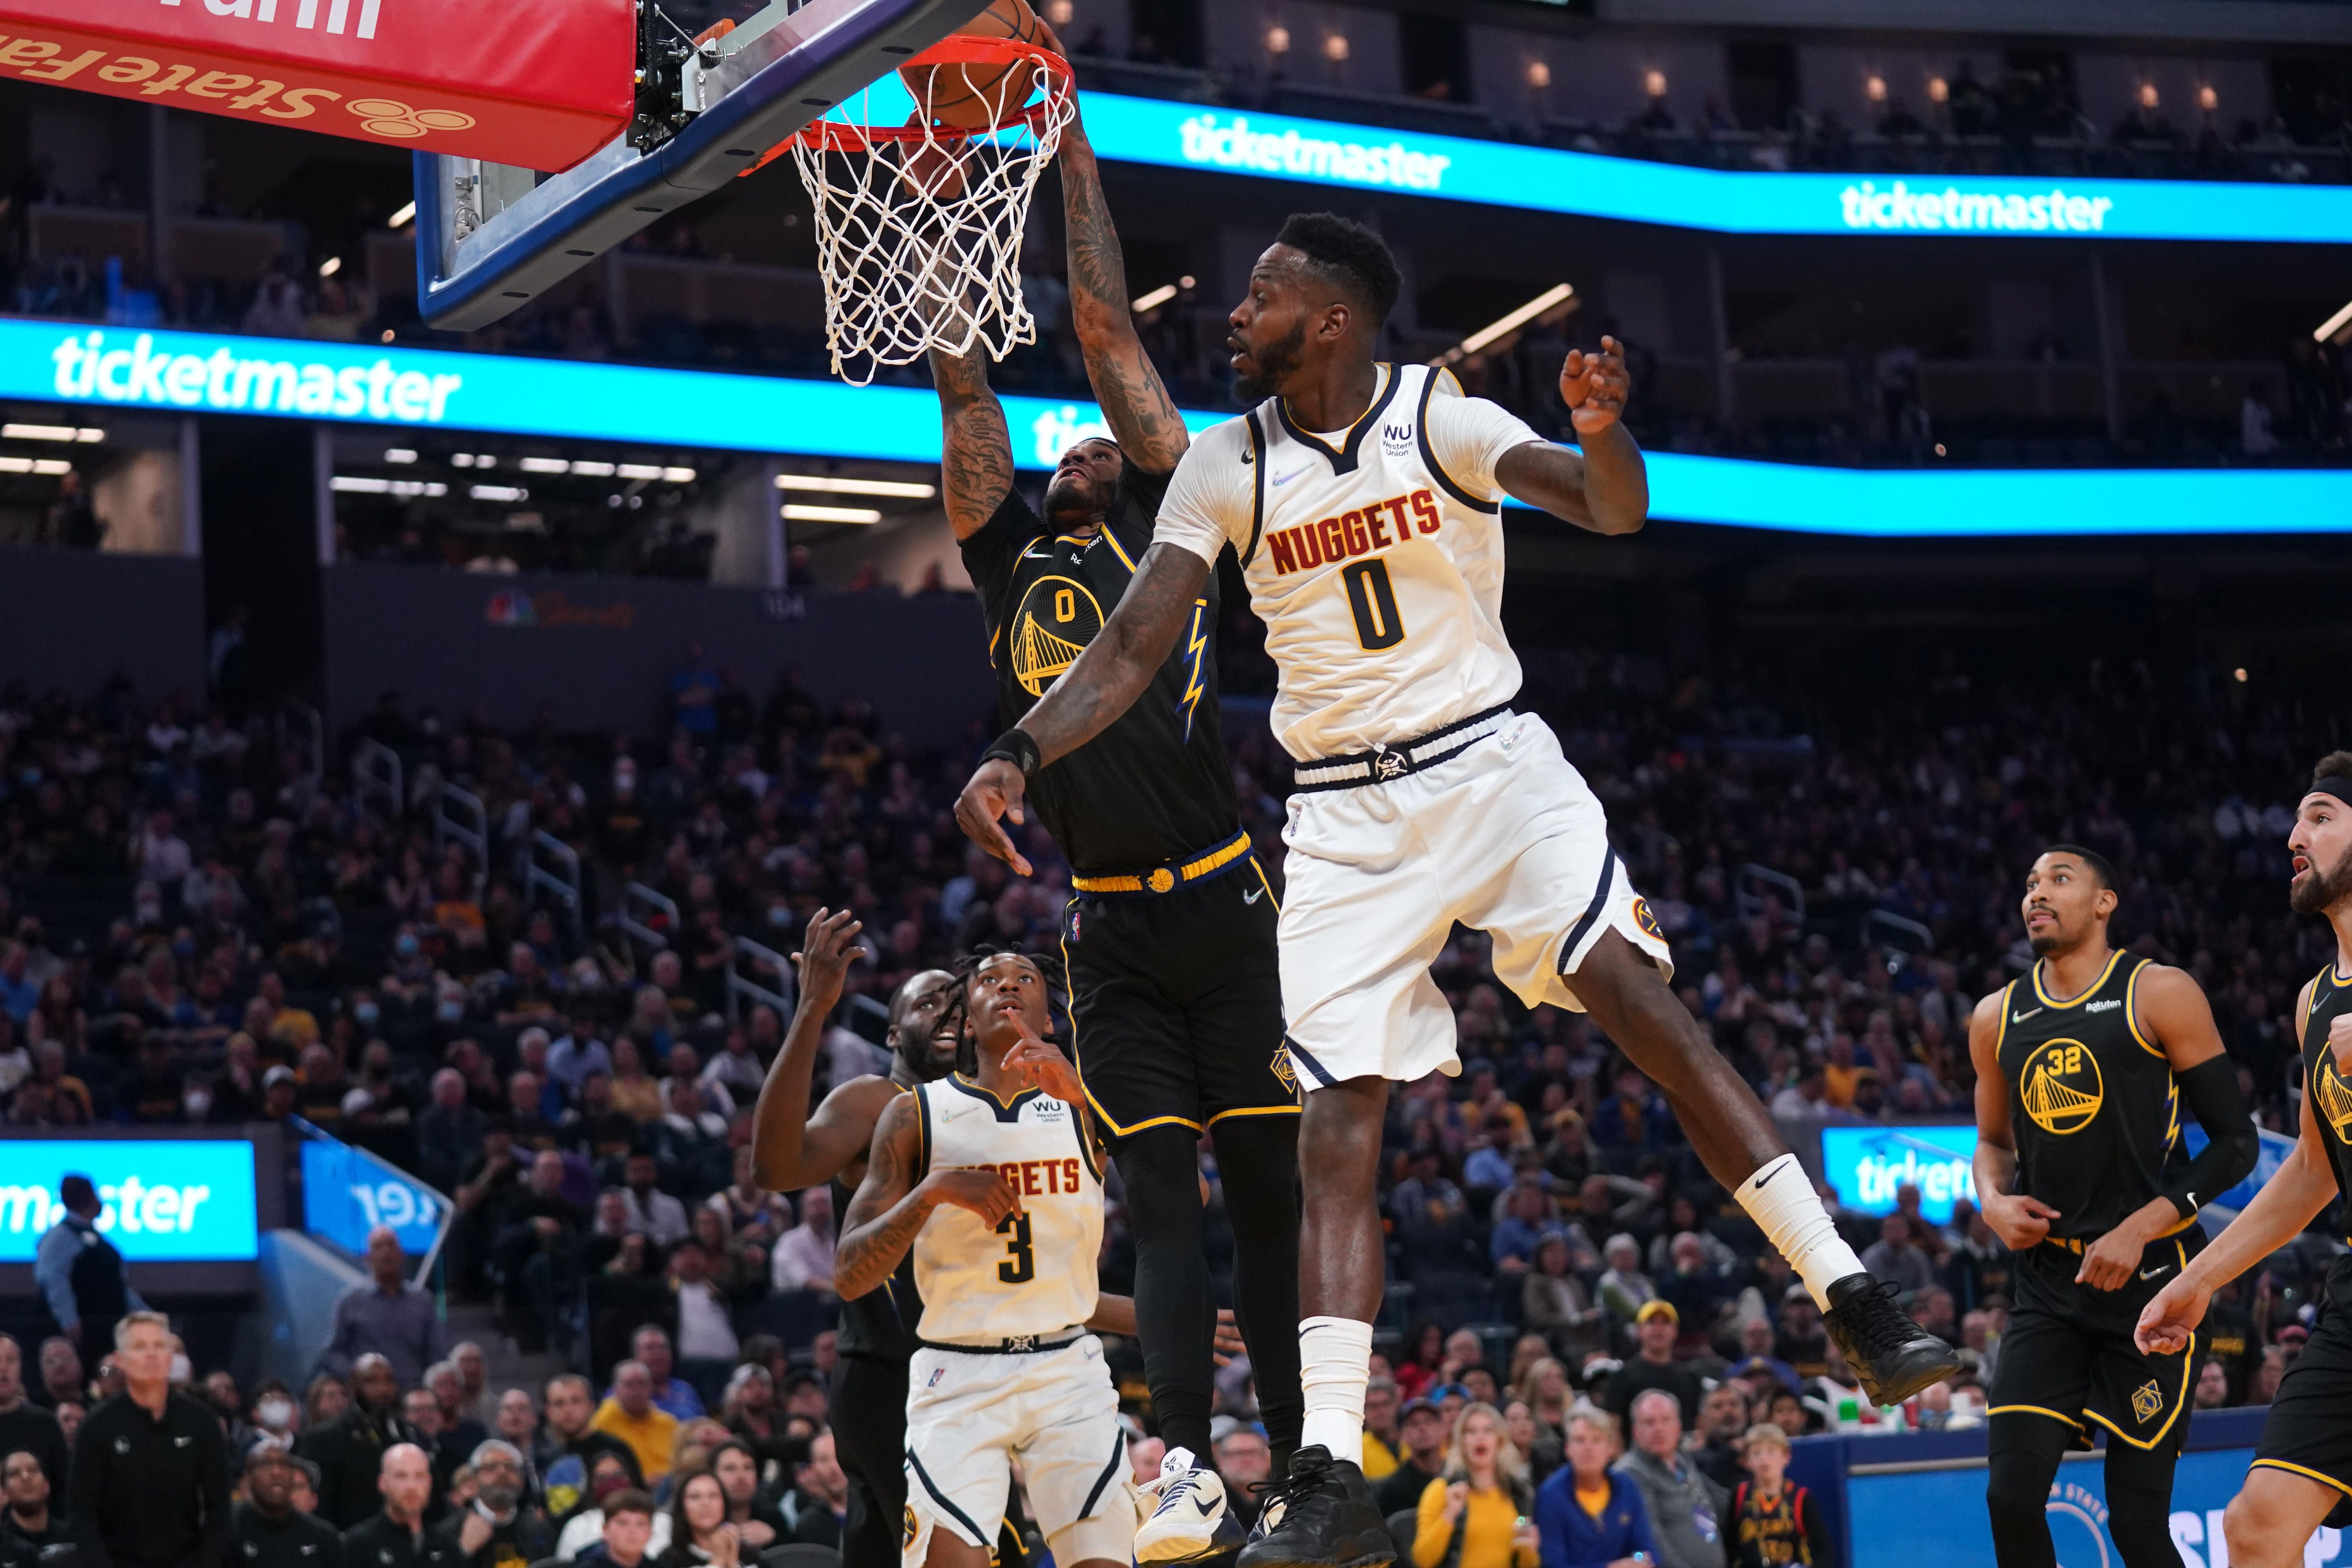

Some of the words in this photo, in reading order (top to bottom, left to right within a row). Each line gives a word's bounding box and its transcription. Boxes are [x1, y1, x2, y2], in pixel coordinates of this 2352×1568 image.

[0, 36, 107, 81] Fa
[98, 56, 342, 118] State
[1179, 113, 1451, 191] ticketmaster
[1839, 180, 2113, 232] ticketmaster
[51, 330, 462, 423] ticketmaster
[1383, 439, 1413, 449] Western
[1384, 422, 1411, 440] WU
[1265, 489, 1442, 577] NUGGETS
[1055, 588, 1075, 623] 0
[1338, 555, 1407, 652] 0
[2085, 1000, 2121, 1013] Rakuten
[2047, 1045, 2082, 1076] 32
[1032, 1101, 1061, 1112] WU
[0, 1175, 210, 1234] mster
[994, 1210, 1036, 1285] 3
